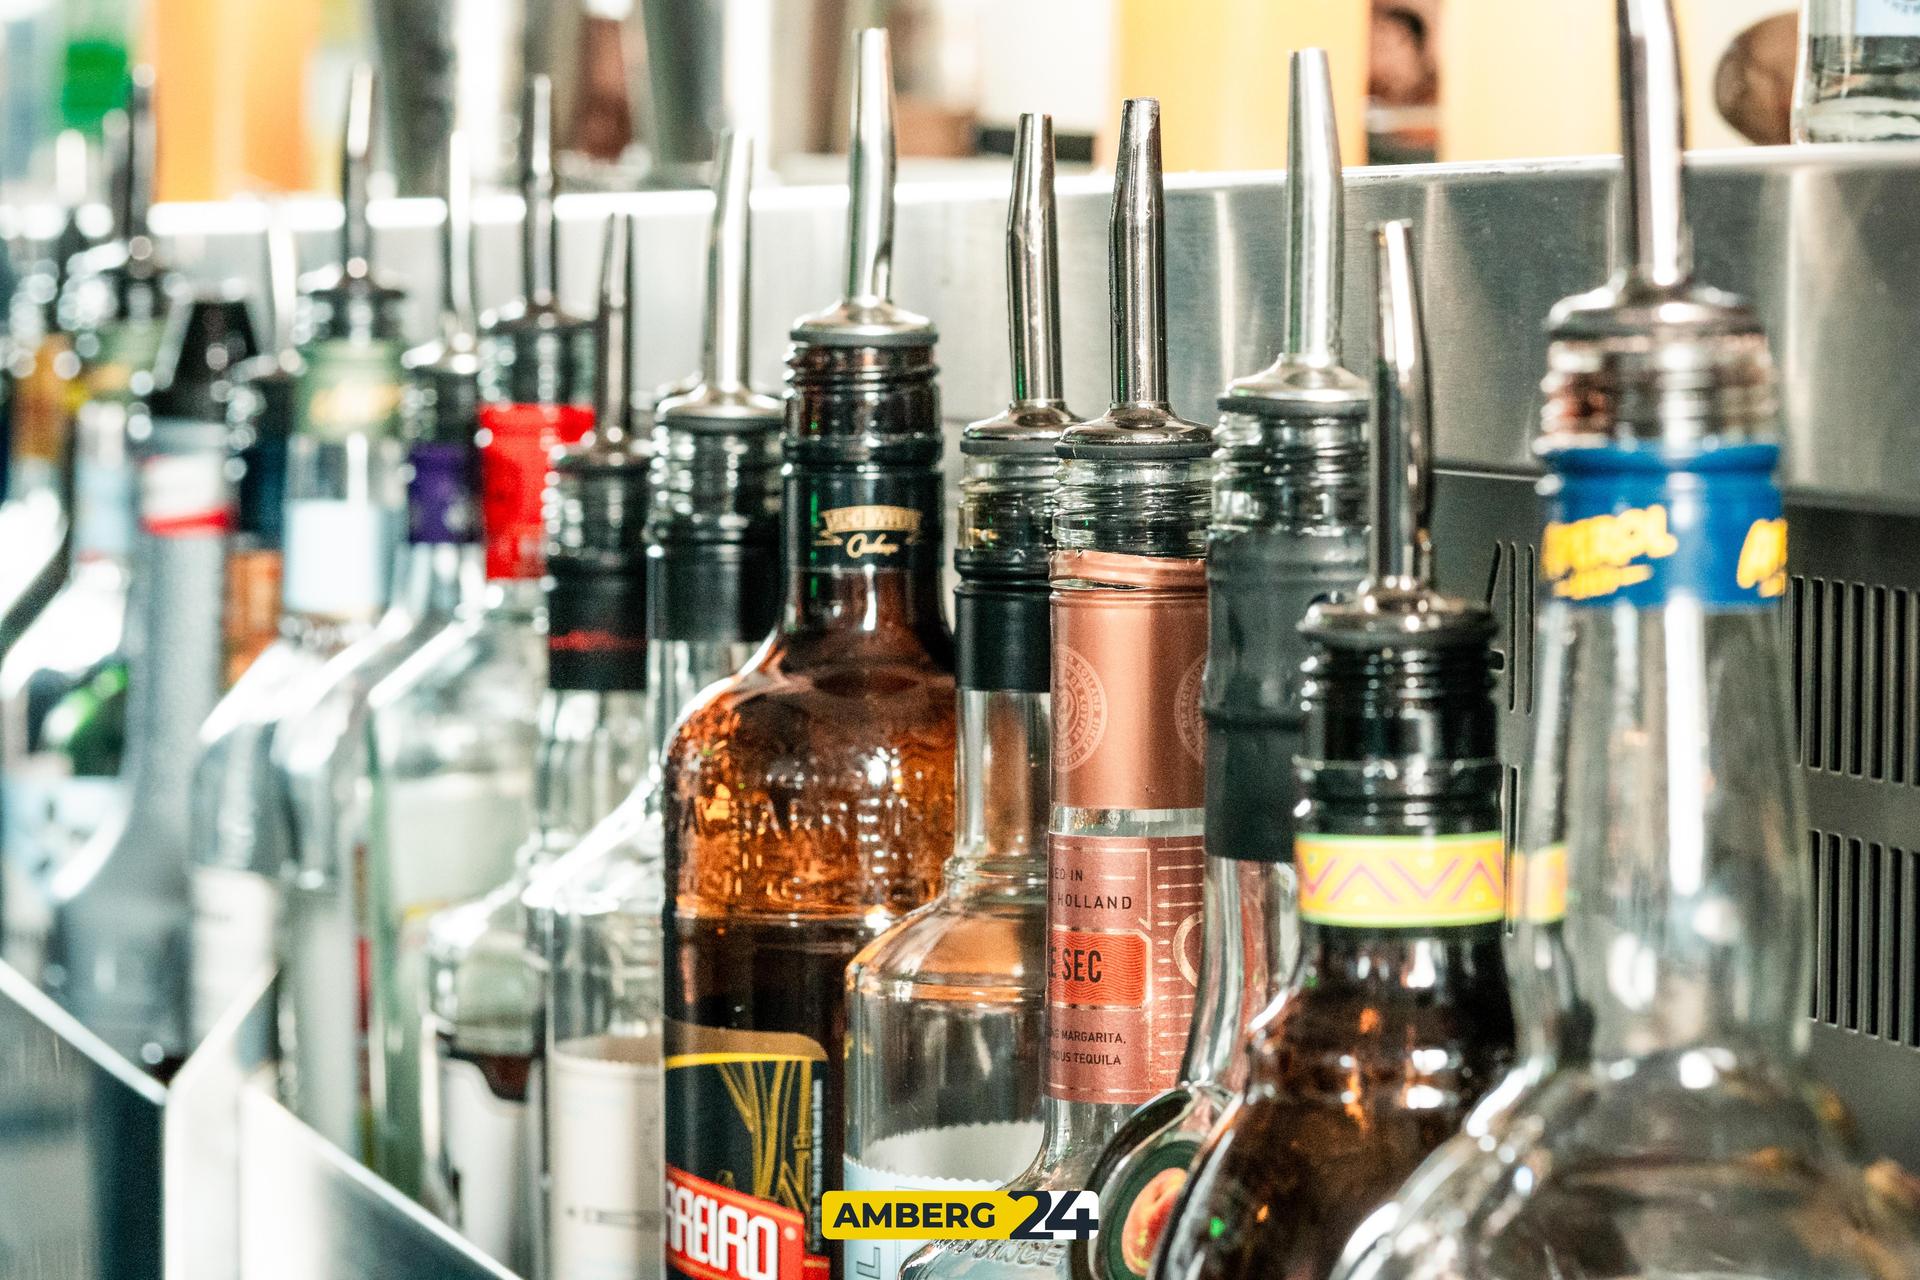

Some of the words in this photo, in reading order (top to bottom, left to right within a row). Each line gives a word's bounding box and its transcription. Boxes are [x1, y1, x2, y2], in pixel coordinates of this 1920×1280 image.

[1070, 869, 1083, 881] IN
[1057, 893, 1132, 910] HOLLAND
[1062, 948, 1102, 983] SEC
[1073, 1052, 1121, 1065] TEQUILA
